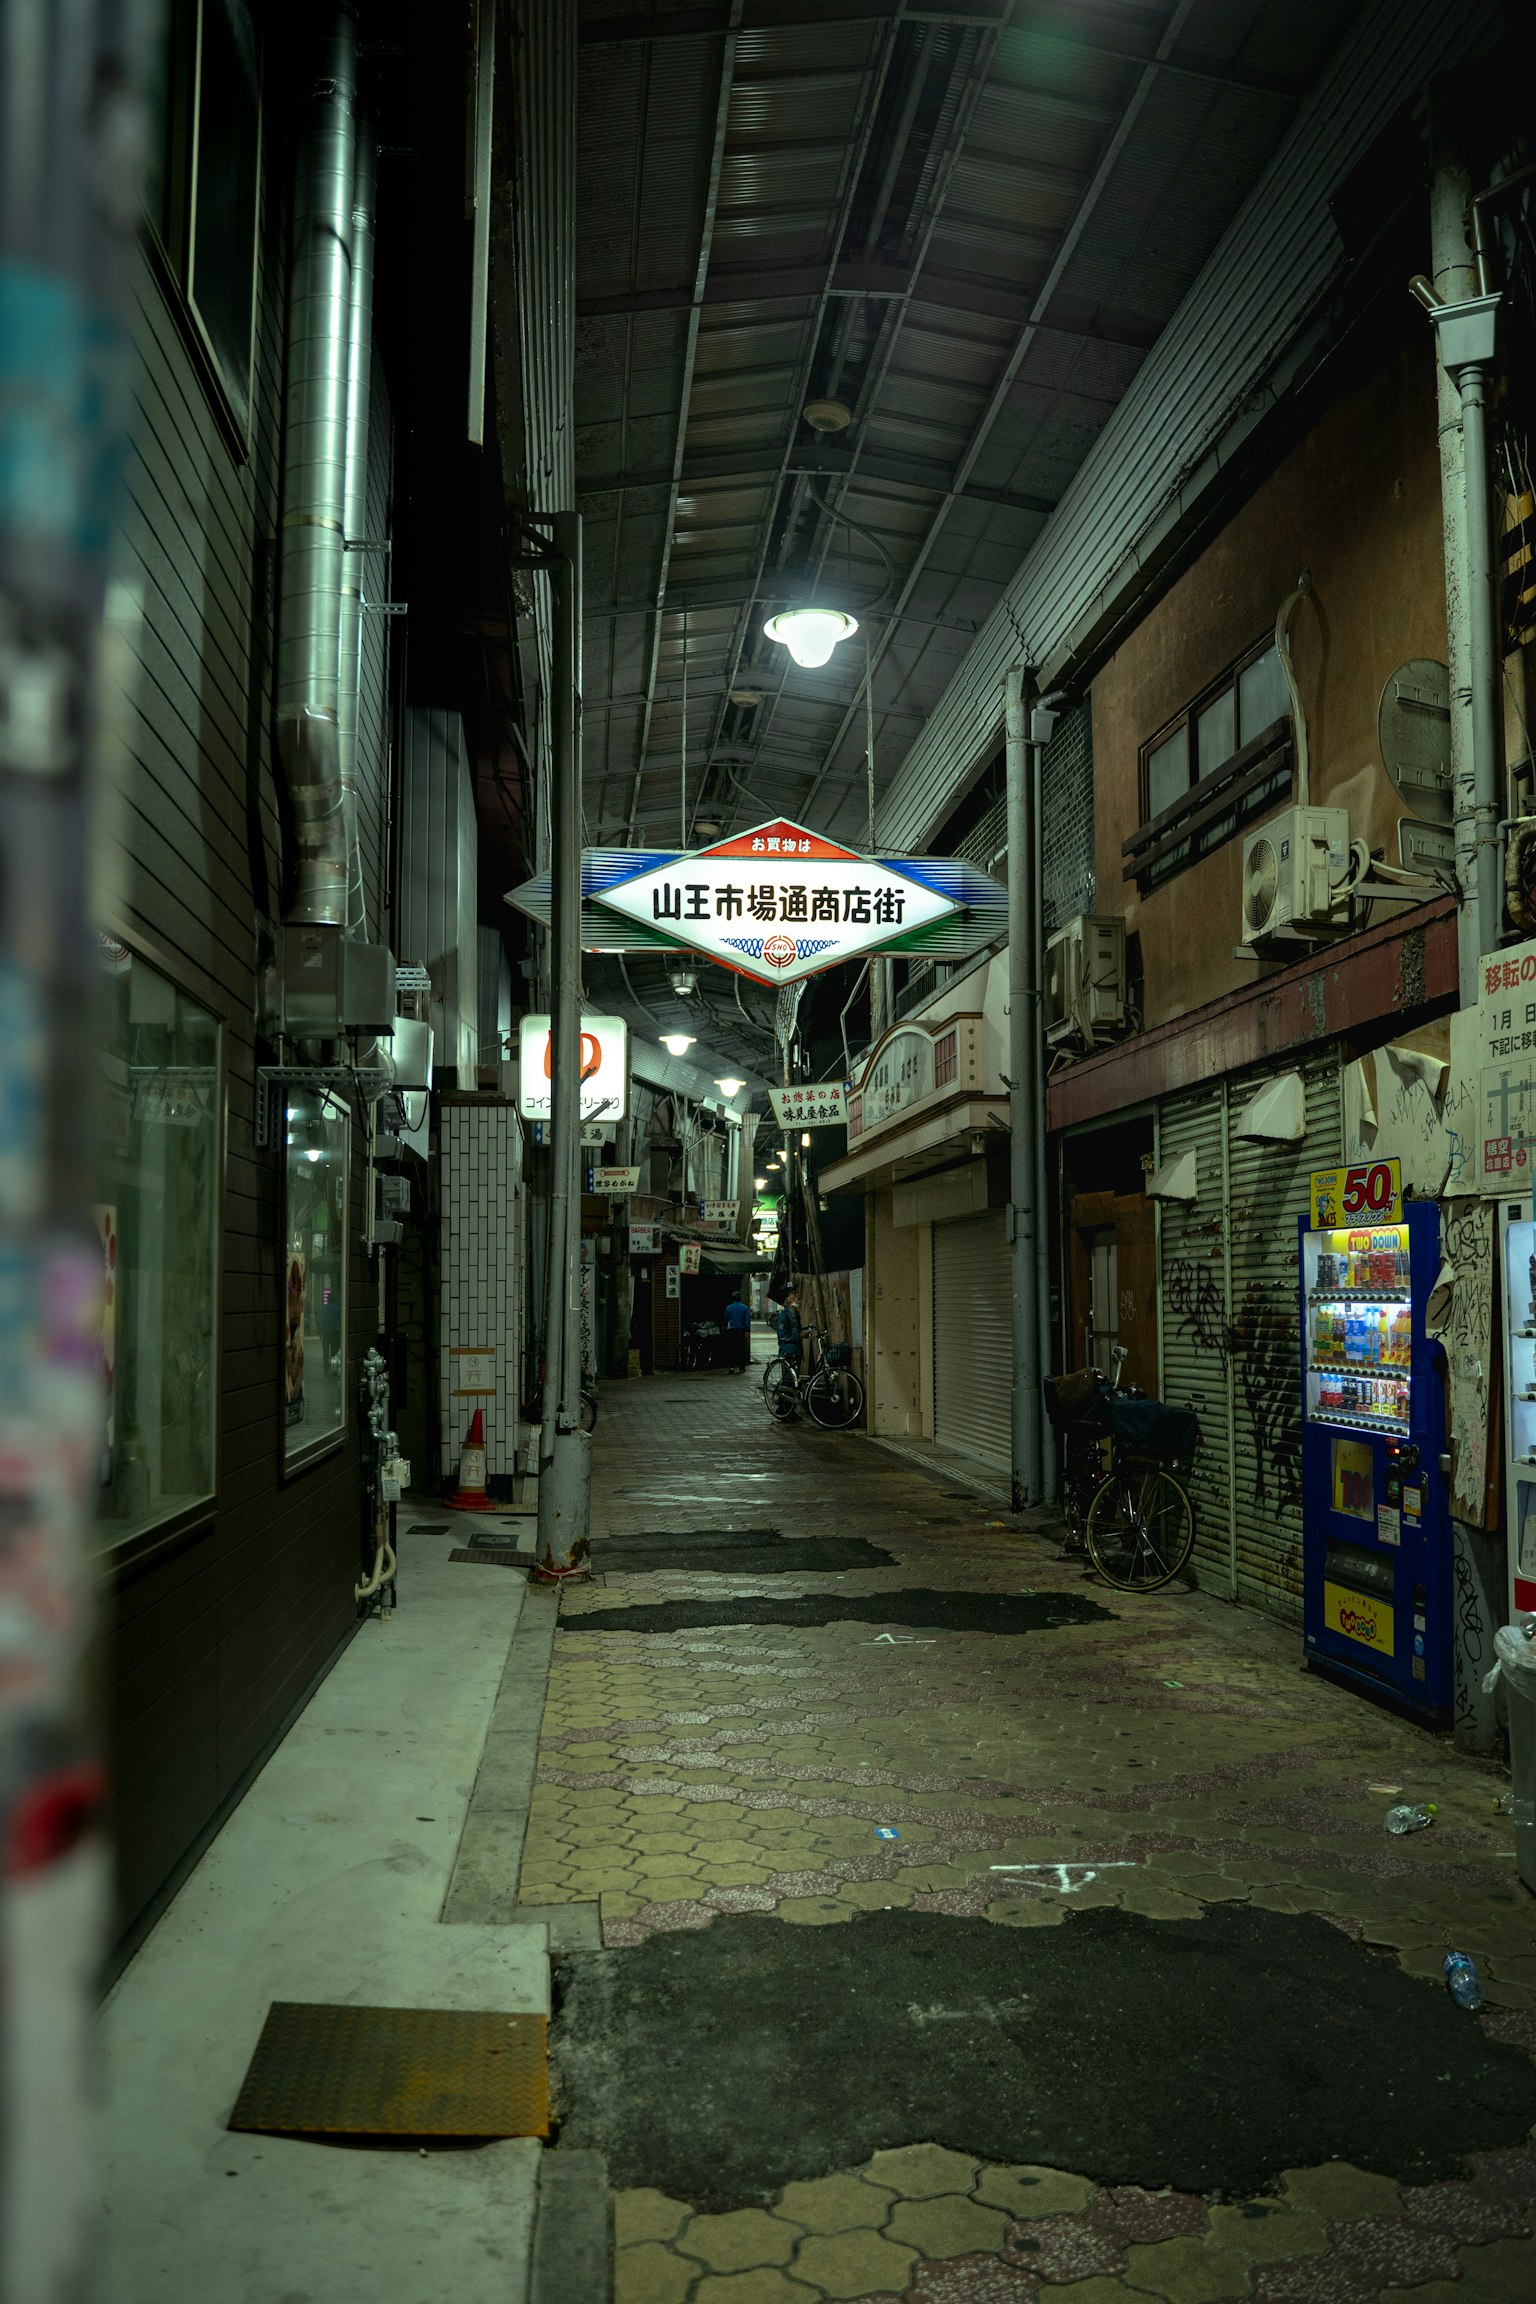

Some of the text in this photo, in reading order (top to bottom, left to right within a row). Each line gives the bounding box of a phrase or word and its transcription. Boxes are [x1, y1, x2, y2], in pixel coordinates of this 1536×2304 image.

[751, 837, 811, 853] お買物は
[653, 882, 906, 925] 山王市場通商店街
[1492, 1009, 1511, 1031] 1月
[781, 1089, 840, 1104] お惣菜の店
[783, 1104, 840, 1121] 味見屋食品
[1487, 1140, 1509, 1156] 悟空
[631, 1226, 652, 1234] BARBER
[1350, 1234, 1398, 1251] TWO DOWN
[1341, 1613, 1375, 1637] TWO DOWN
